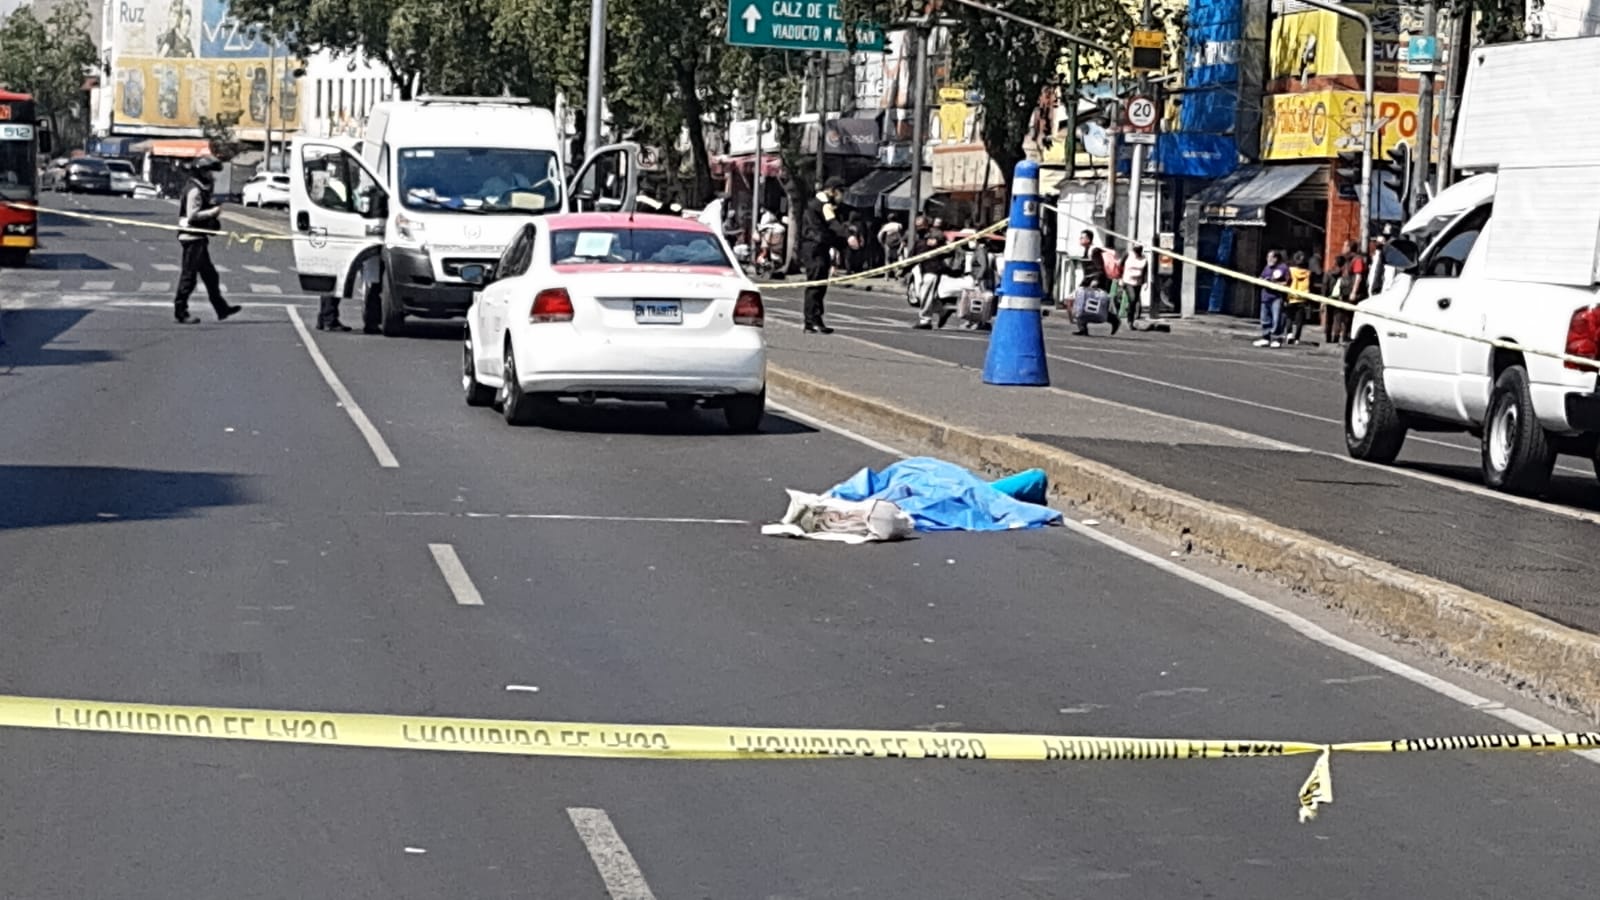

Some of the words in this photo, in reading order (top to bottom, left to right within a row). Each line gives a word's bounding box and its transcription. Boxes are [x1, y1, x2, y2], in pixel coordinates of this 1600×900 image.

[772, 1, 802, 17] CALZ
[807, 3, 822, 18] DE
[772, 24, 819, 41] VIADUCTO
[824, 27, 832, 41] M
[1133, 102, 1152, 117] 20
